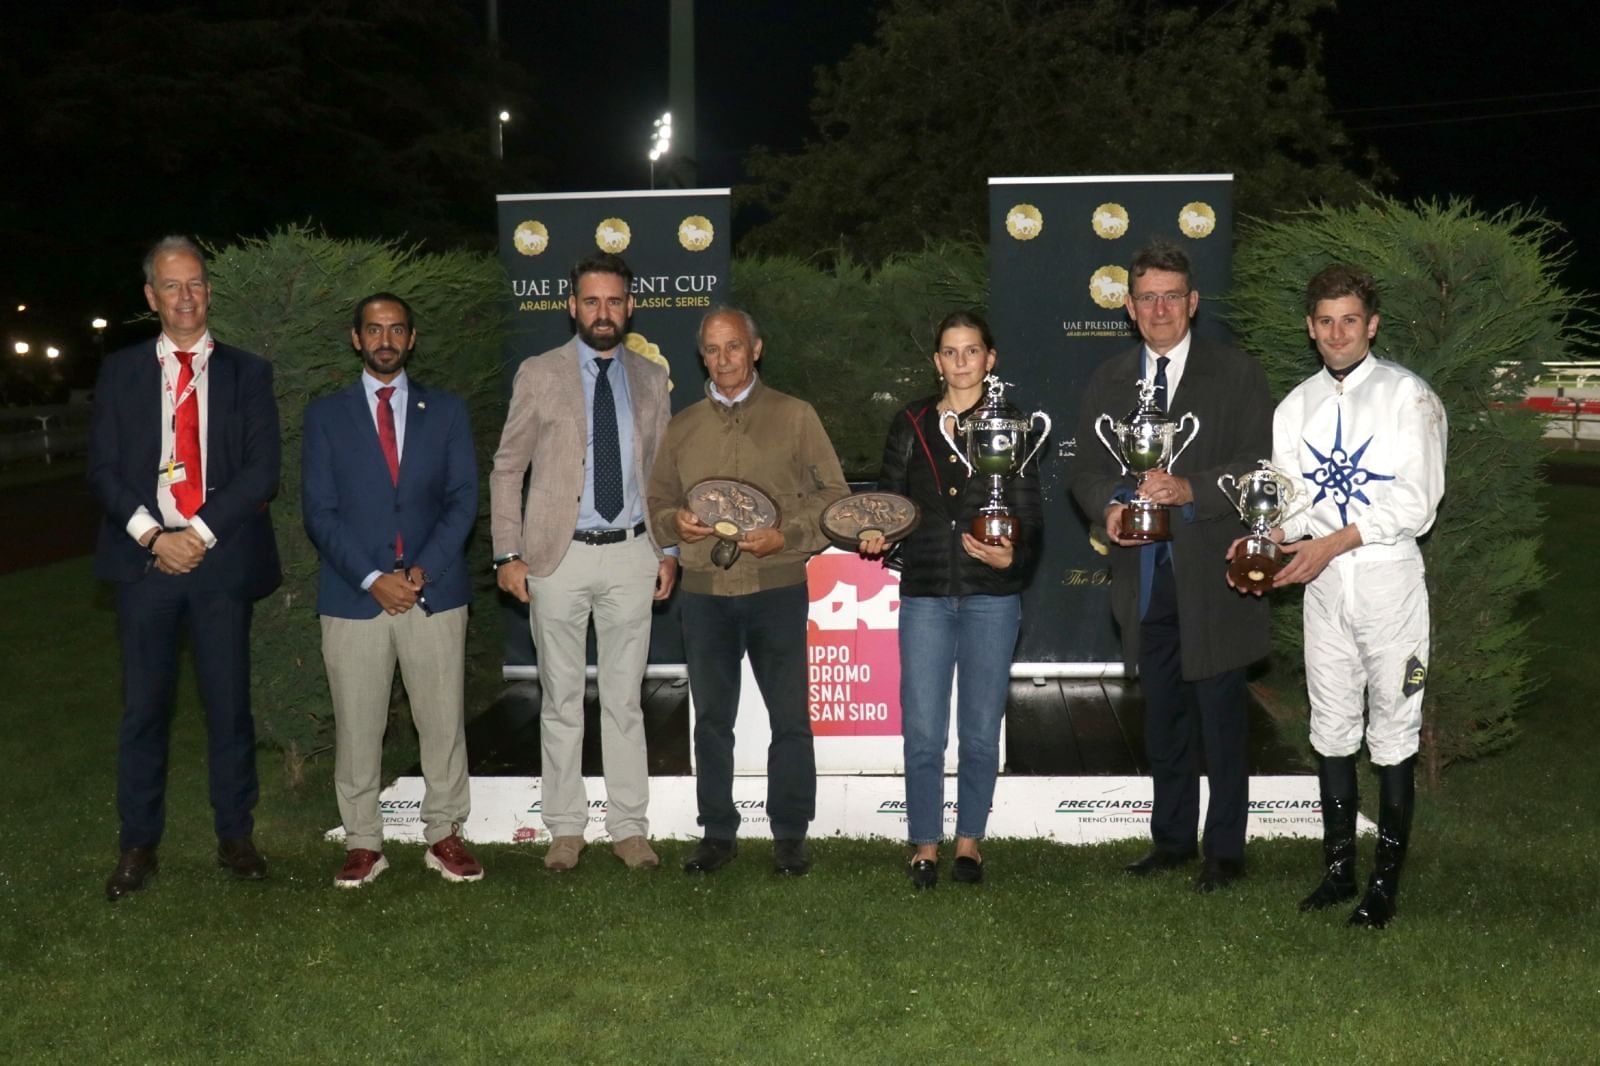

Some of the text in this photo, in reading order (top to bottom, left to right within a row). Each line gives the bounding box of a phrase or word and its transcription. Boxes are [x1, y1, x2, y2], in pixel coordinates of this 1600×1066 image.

[512, 280, 550, 297] UAE
[675, 275, 717, 292] CUP
[519, 296, 710, 311] ARABIAN LASSIC SERIES
[1063, 321, 1082, 330] UAE
[809, 645, 850, 663] IPPO
[809, 664, 870, 683] DROMO
[809, 684, 850, 702] SNAI
[810, 703, 888, 722] SAN SIRO
[1058, 800, 1153, 809] FRECCIAROS
[1247, 800, 1322, 809] RECCIARO
[1078, 816, 1151, 824] TRENO UFFICIALE
